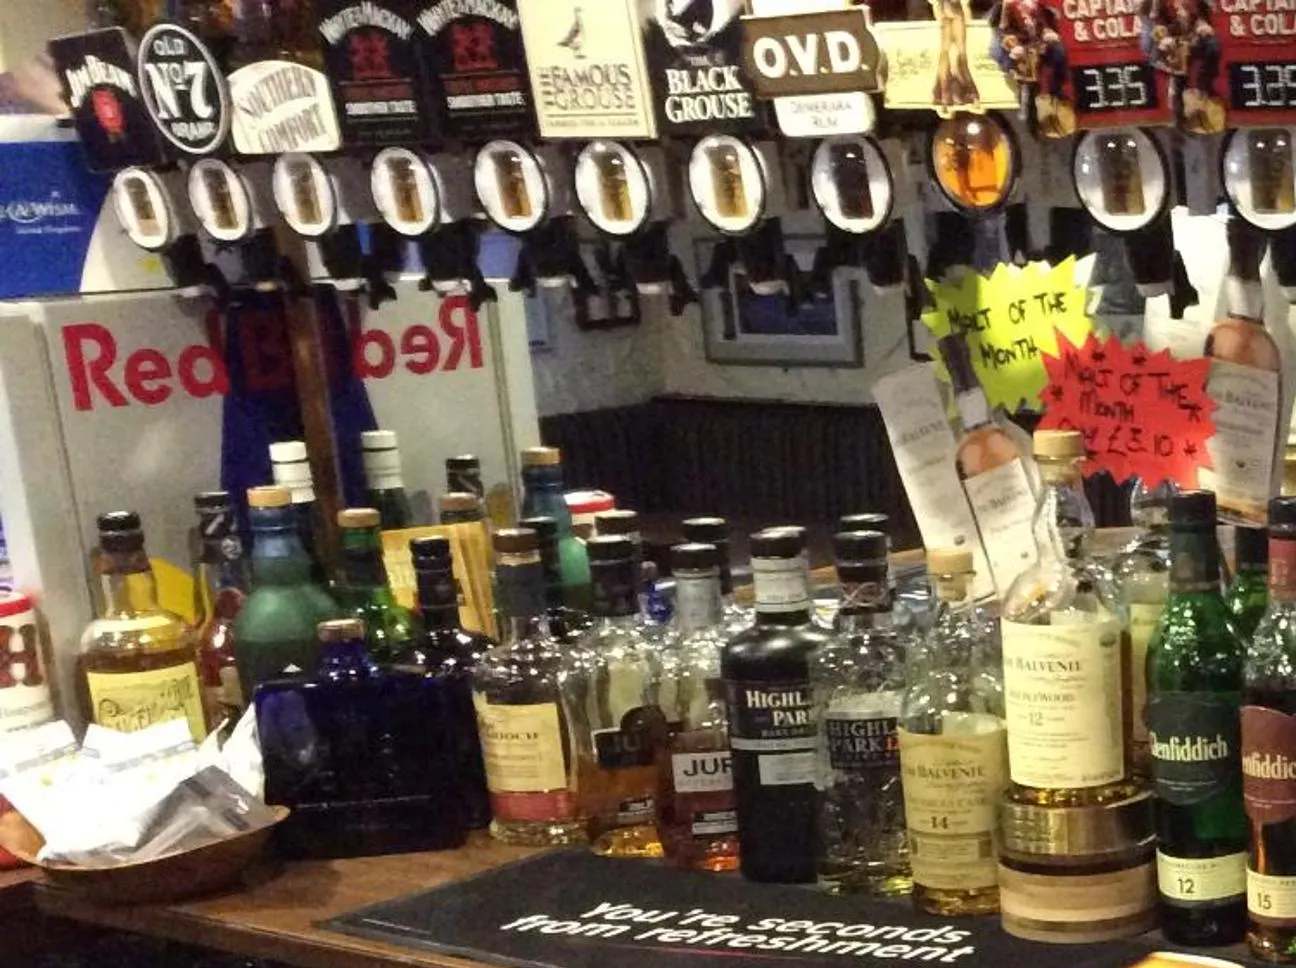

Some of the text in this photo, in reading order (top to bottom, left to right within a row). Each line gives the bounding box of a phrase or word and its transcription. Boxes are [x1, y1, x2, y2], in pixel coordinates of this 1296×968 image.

[1093, 14, 1144, 40] COLA
[153, 35, 188, 56] OLD
[752, 30, 871, 79] O.V.D.
[550, 63, 632, 88] FAMOUS
[664, 65, 743, 96] BLACK
[553, 86, 636, 111] GROUSE
[663, 93, 754, 124] GROUSE
[1008, 300, 1027, 325] OF
[1033, 292, 1069, 315] THE
[978, 337, 1038, 370] MONTH
[1119, 372, 1144, 395] OF
[1147, 371, 1190, 403] THE
[1177, 878, 1195, 895] 12
[1257, 892, 1273, 910] 15
[500, 914, 976, 963] from refreshment
[580, 902, 973, 944] You're seconds
